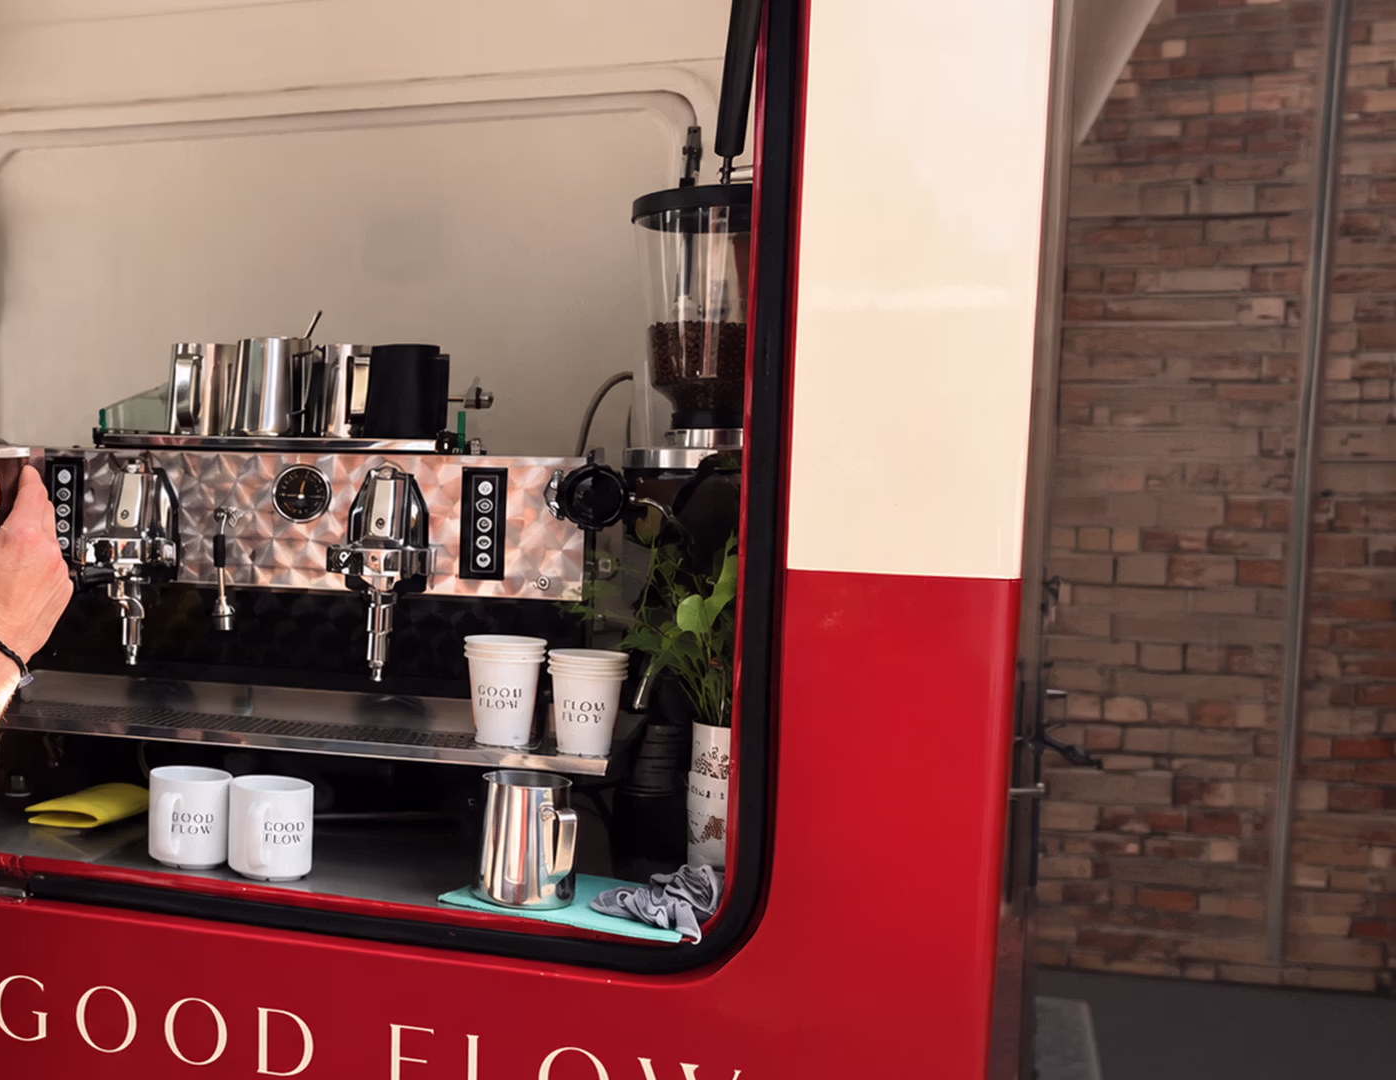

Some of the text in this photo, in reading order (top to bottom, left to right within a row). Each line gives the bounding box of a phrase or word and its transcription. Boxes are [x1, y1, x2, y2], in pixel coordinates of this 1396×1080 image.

[171, 811, 214, 823] GOOD
[171, 824, 213, 834] FLOW
[264, 821, 305, 832] GOOD
[264, 833, 303, 845] FLOW
